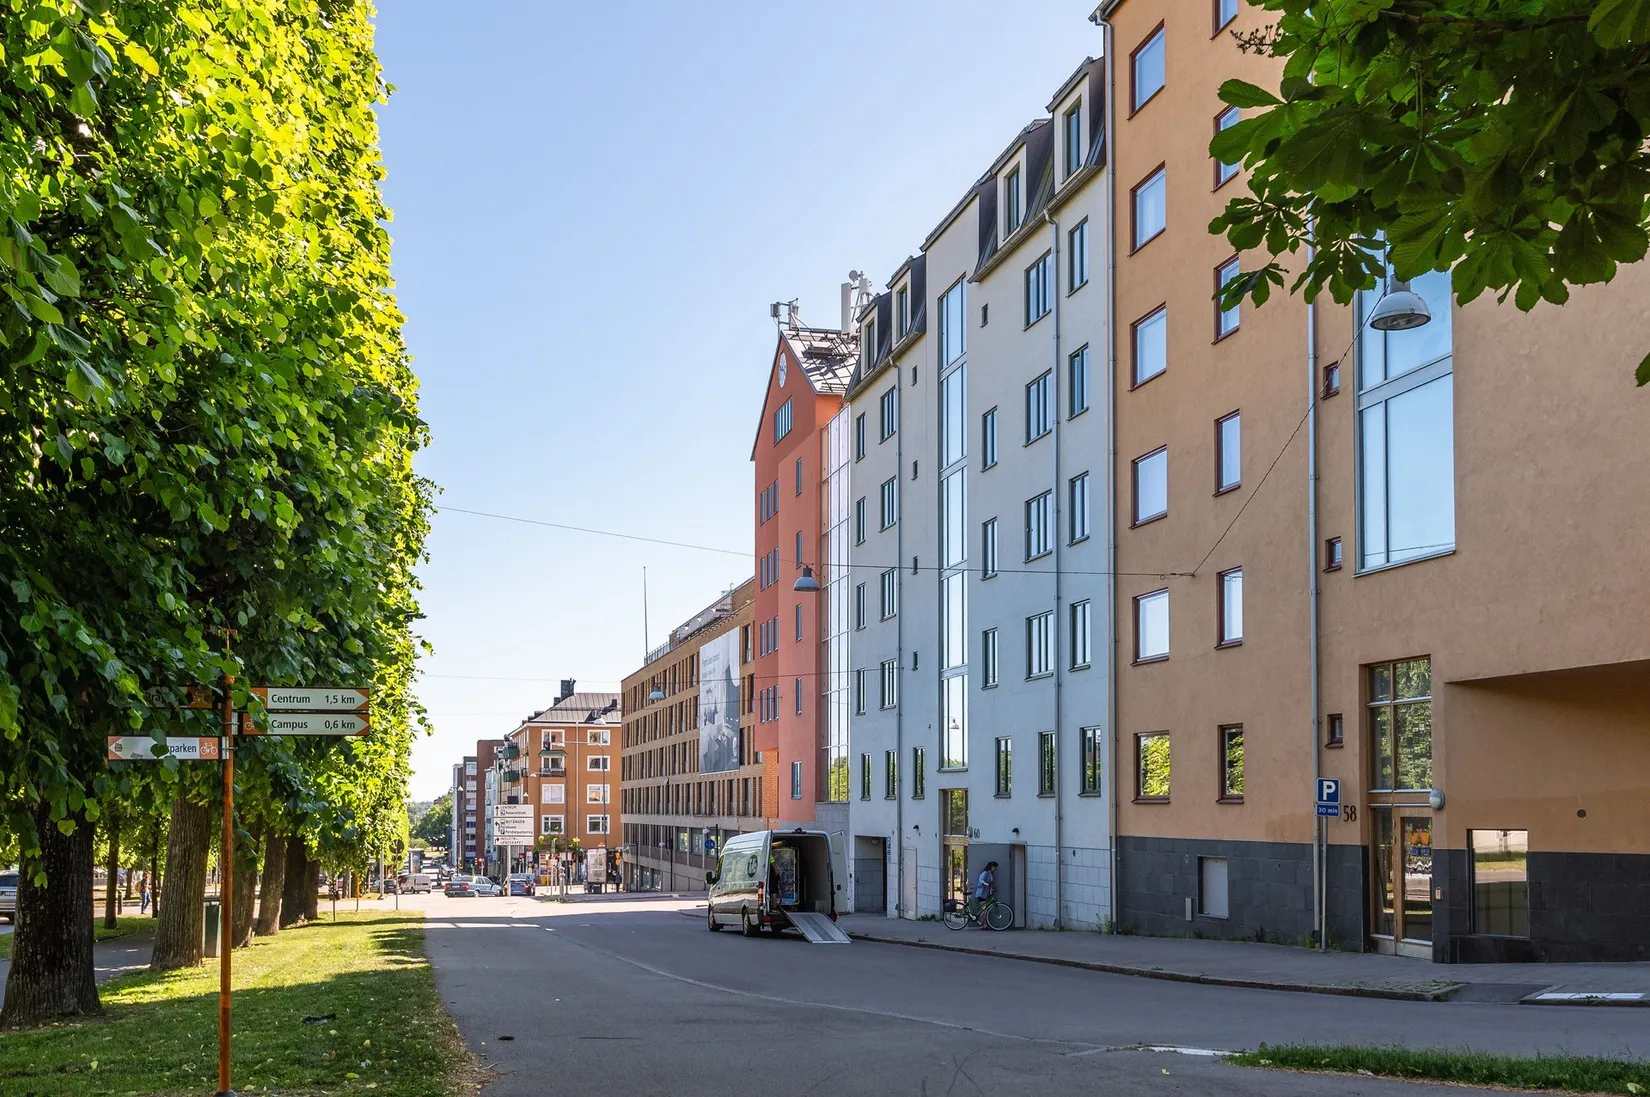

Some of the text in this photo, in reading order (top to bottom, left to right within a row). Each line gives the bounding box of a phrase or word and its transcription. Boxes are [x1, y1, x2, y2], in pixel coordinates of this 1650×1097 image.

[271, 693, 355, 705] Centrum 1,5 km
[271, 719, 355, 731] Campus 0,6 km
[168, 743, 197, 755] parken
[1323, 781, 1336, 800] P
[1343, 805, 1357, 822] 58
[974, 828, 980, 839] 60
